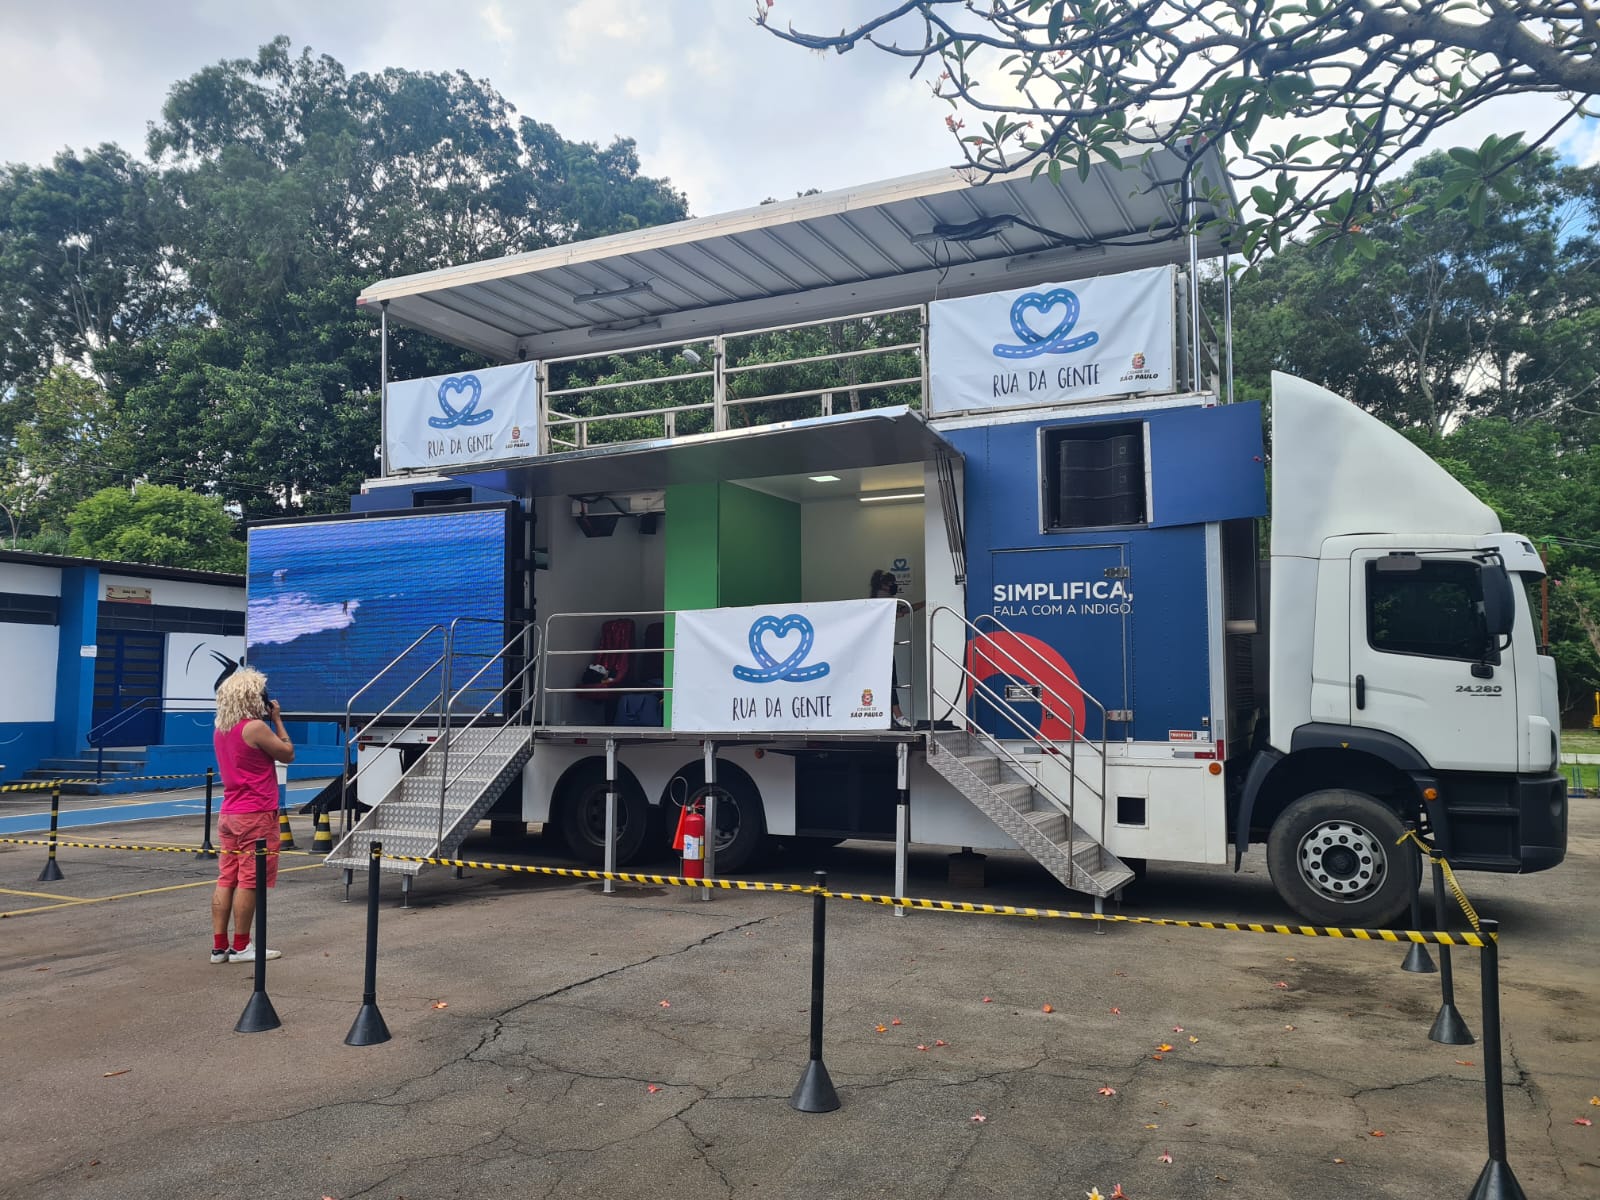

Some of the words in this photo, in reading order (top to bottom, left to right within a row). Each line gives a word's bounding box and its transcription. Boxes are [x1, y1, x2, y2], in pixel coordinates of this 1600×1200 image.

[993, 372, 1019, 398] RUA
[1029, 370, 1047, 391] DA
[1057, 363, 1100, 389] GENTE
[428, 440, 445, 459] RUA
[450, 439, 463, 455] DA
[467, 433, 494, 453] GENTE
[993, 581, 1134, 602] SIMPLIFICA,
[993, 605, 1028, 617] FALA
[1031, 604, 1063, 616] COM
[1066, 604, 1077, 615] A
[732, 697, 757, 721] RUA
[766, 697, 782, 718] DA
[791, 695, 832, 719] GENTE
